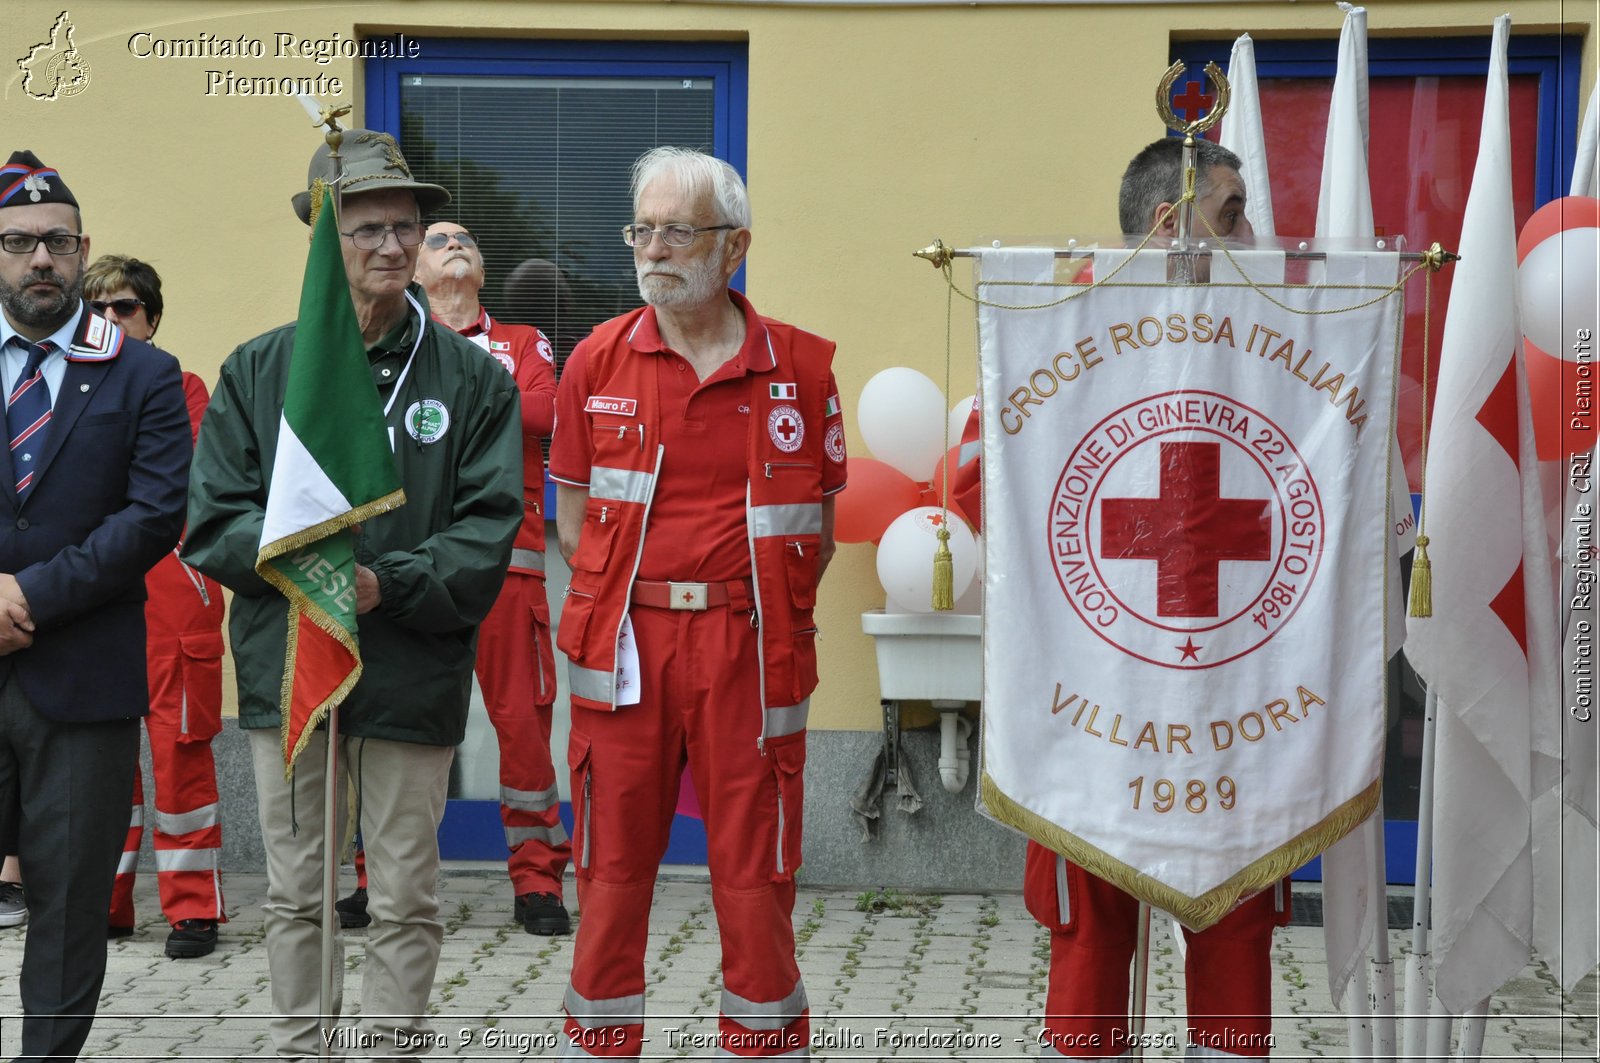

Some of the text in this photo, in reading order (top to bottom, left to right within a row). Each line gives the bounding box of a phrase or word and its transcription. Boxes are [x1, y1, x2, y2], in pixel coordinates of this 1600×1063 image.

[591, 399, 629, 412] Mauro F.
[1000, 313, 1370, 443] CROCE ROSSA ITALIANA
[1056, 399, 1317, 631] CONVENZIONE DI GINEVRA 22 AGOSTO 1864
[1051, 682, 1326, 754] VILLAR DORA
[1128, 775, 1237, 814] 1989
